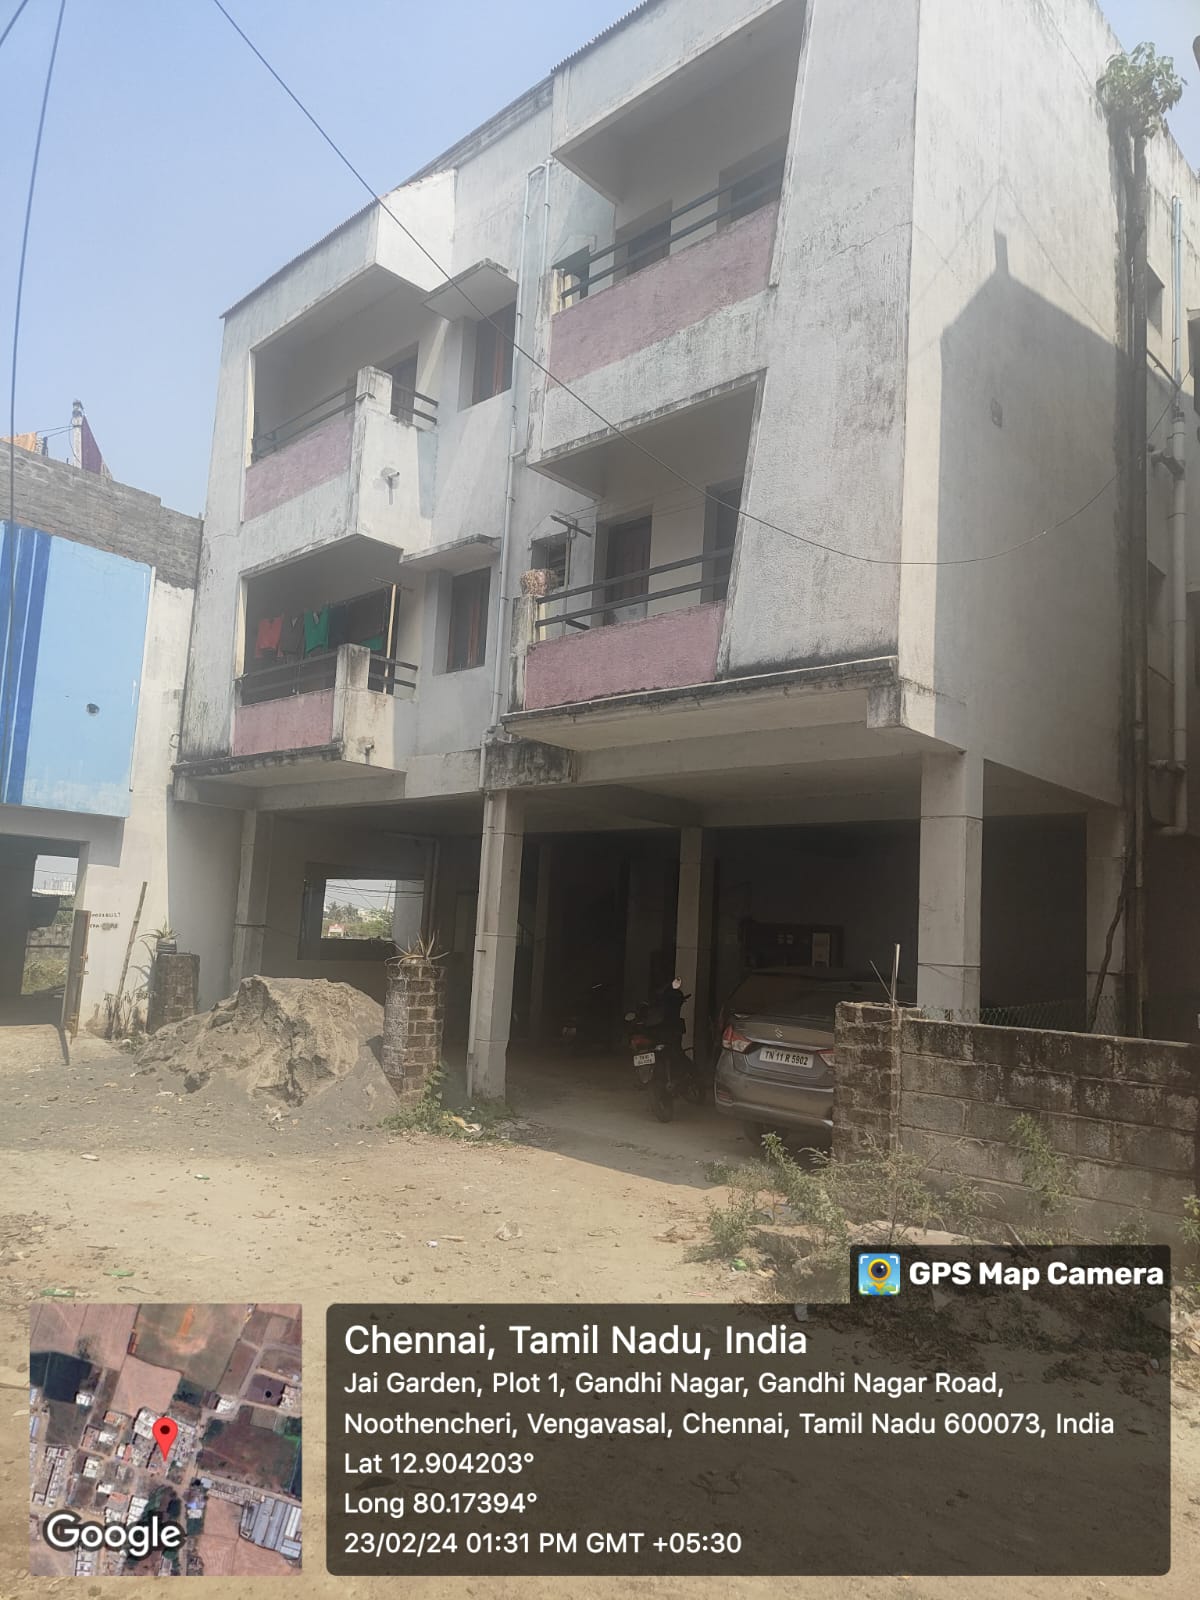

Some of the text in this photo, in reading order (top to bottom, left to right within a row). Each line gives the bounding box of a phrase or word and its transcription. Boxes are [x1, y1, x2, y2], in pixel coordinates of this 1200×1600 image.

[765, 1050, 809, 1066] TN 11 R 5902
